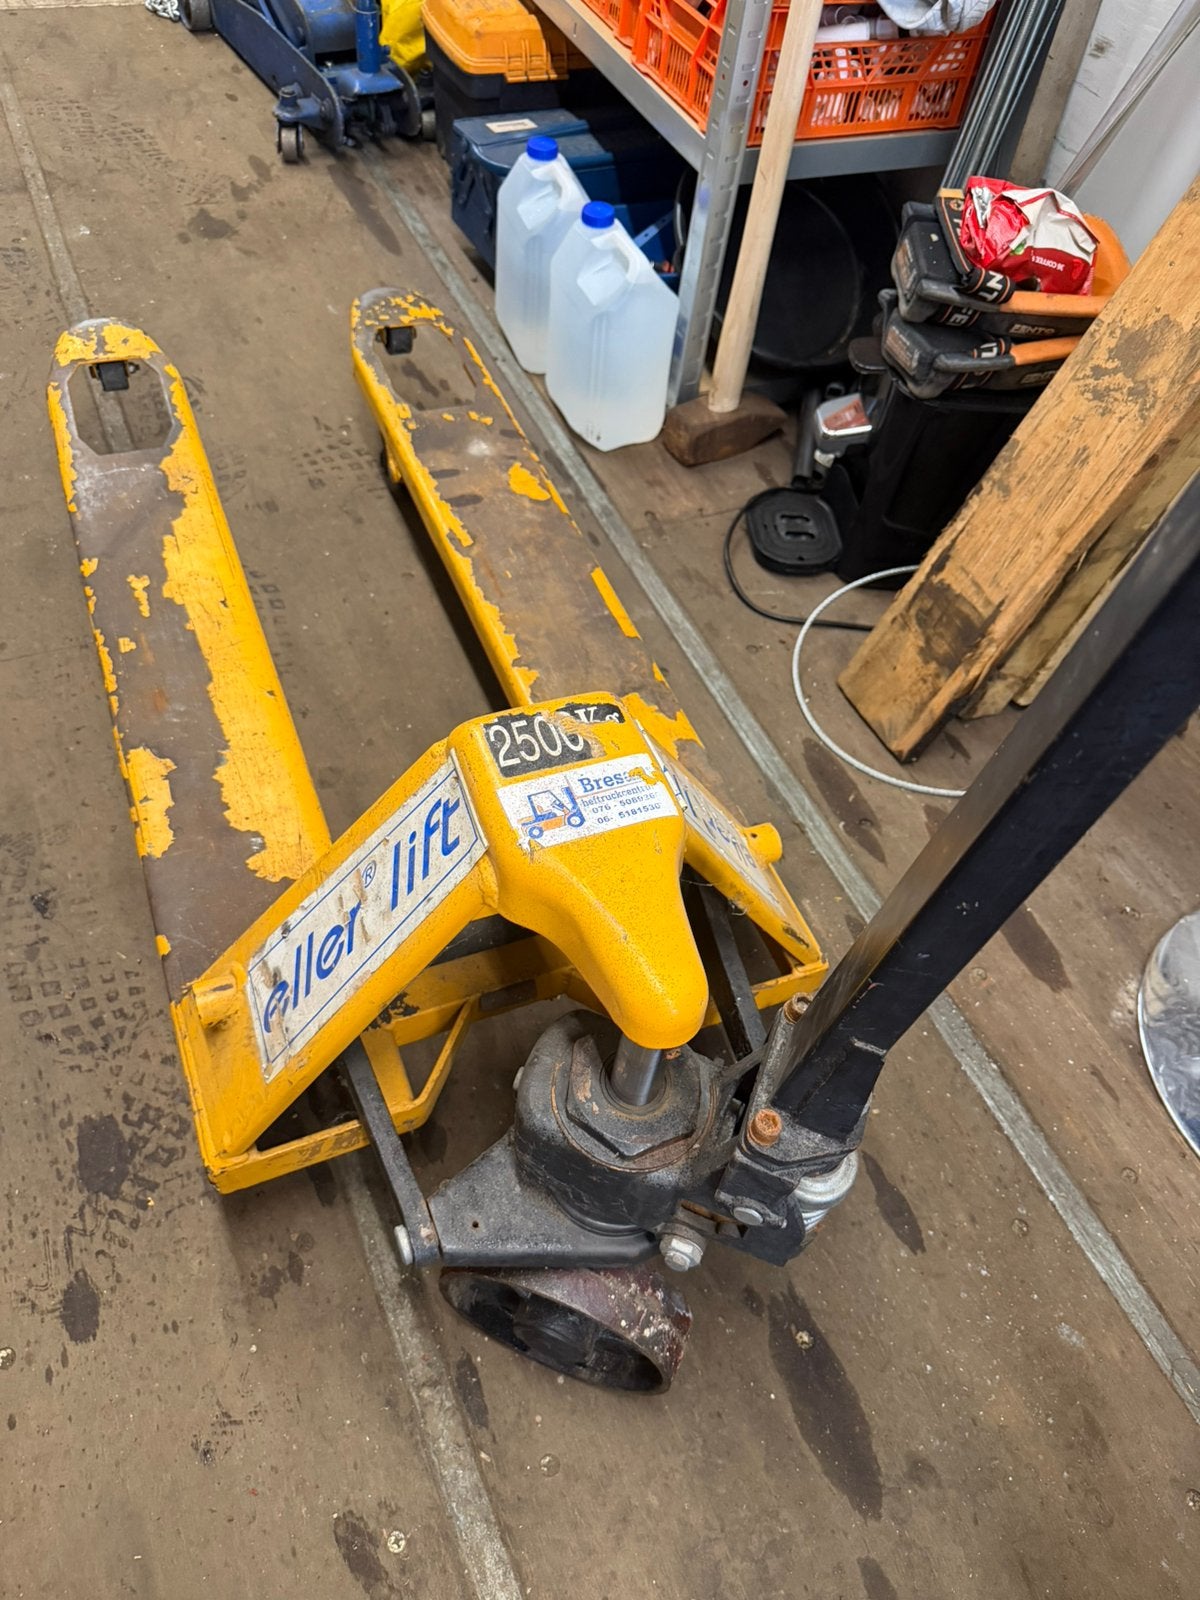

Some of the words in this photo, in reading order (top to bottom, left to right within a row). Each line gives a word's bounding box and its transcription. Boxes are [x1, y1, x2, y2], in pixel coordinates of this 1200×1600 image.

[592, 803, 611, 814] 076
[263, 900, 361, 1033] eller
[390, 798, 460, 912] lift
